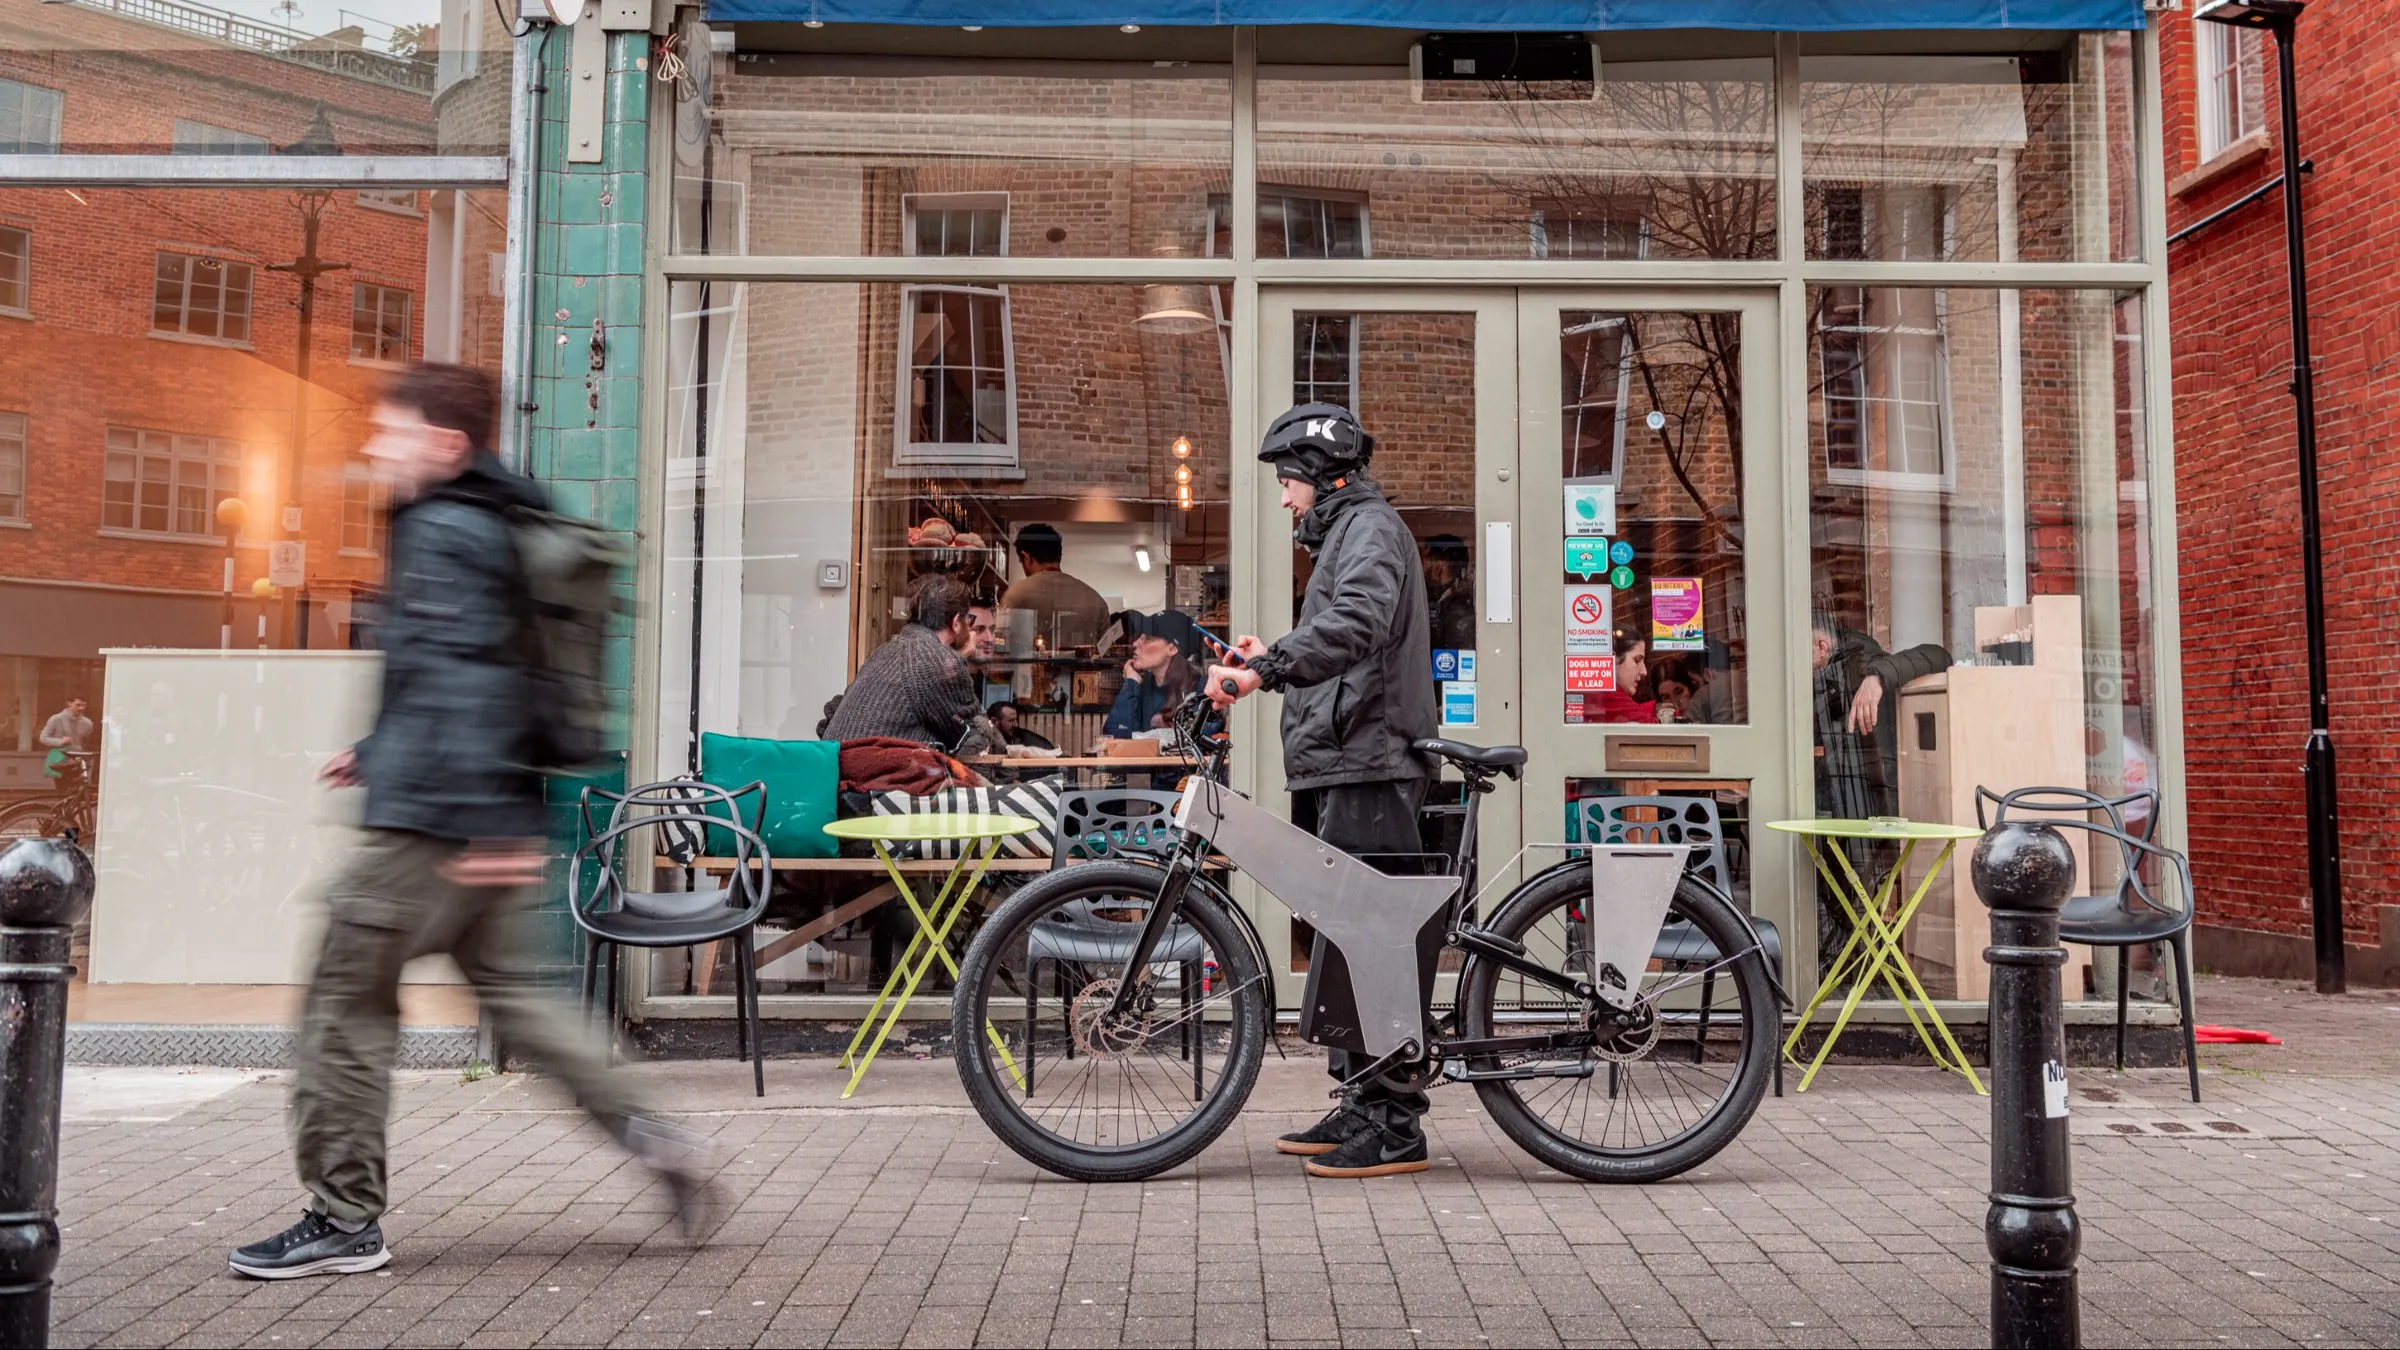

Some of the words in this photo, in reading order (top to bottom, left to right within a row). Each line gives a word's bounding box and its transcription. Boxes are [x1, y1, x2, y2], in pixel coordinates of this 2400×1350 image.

[1569, 670, 1579, 678] BE
[1580, 670, 1599, 678] KEPT
[1601, 670, 1612, 678] ON
[1591, 660, 1611, 668] MUST
[966, 953, 988, 1074] SCHWALBE
[1224, 1043, 1250, 1097] SUPER
[1536, 1135, 1656, 1169] SCHWALBE
